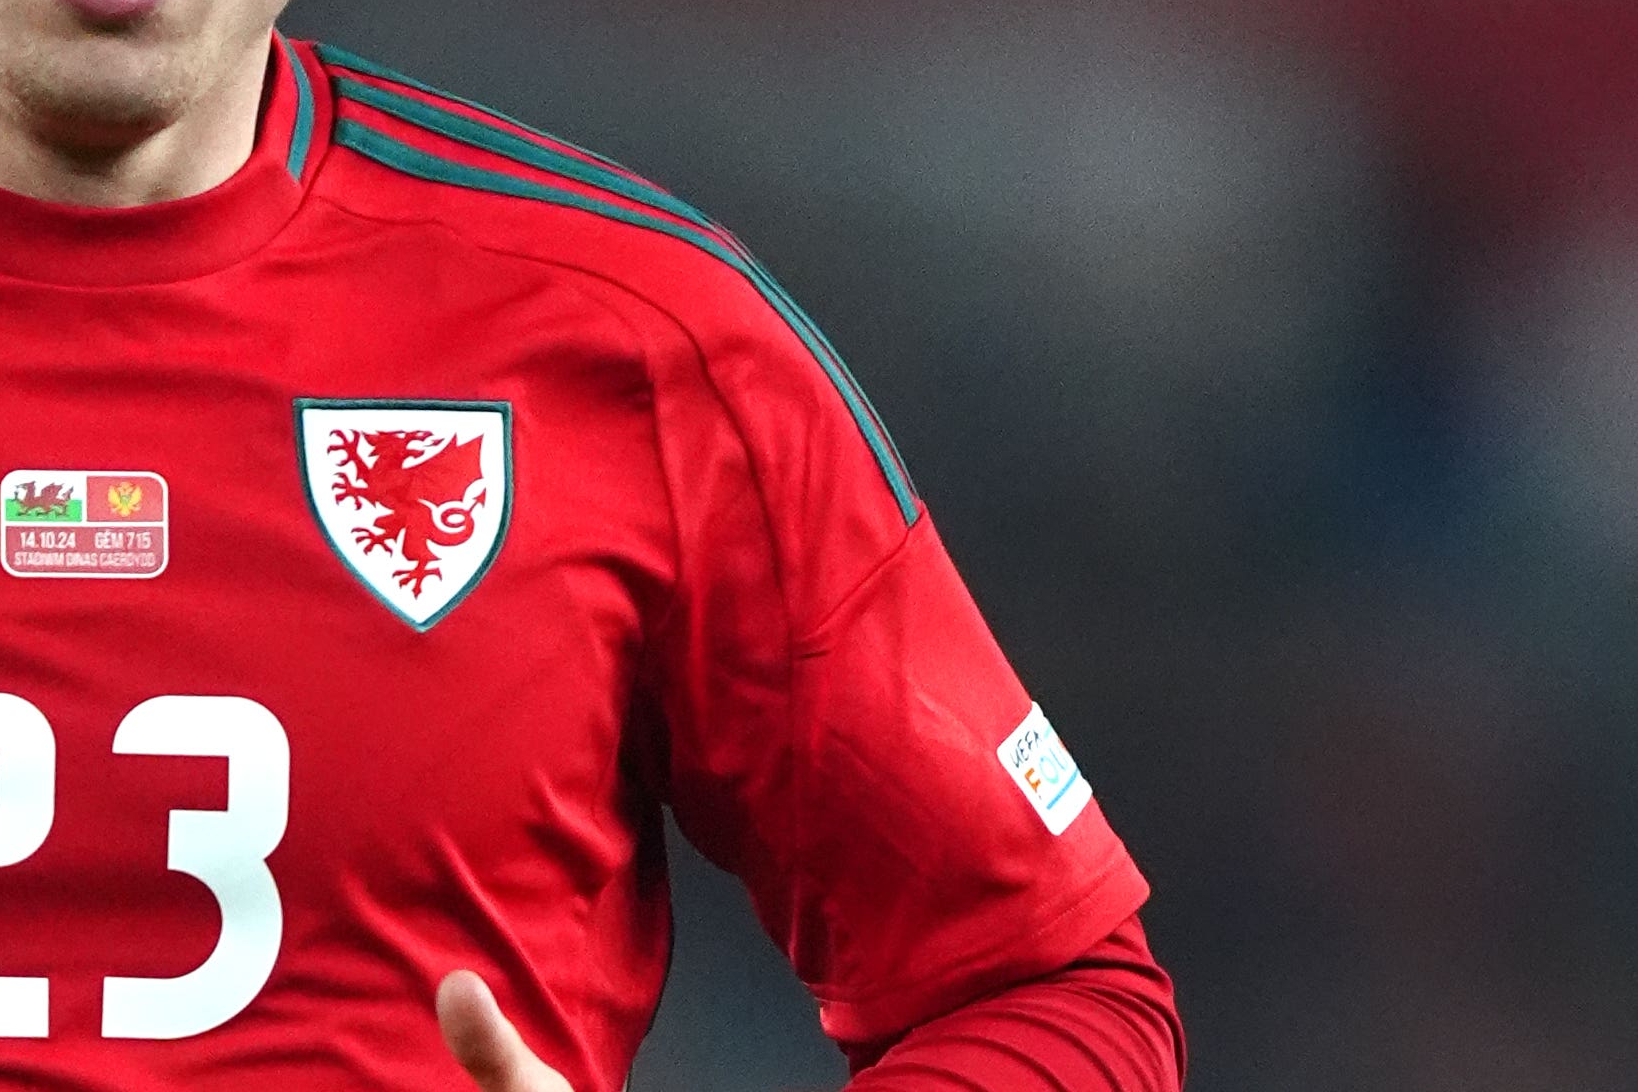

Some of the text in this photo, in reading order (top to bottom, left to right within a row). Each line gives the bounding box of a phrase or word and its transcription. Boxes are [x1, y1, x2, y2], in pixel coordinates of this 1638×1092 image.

[20, 531, 76, 549] 14.10.24
[126, 531, 152, 549] 715
[1010, 730, 1043, 769] UEFA
